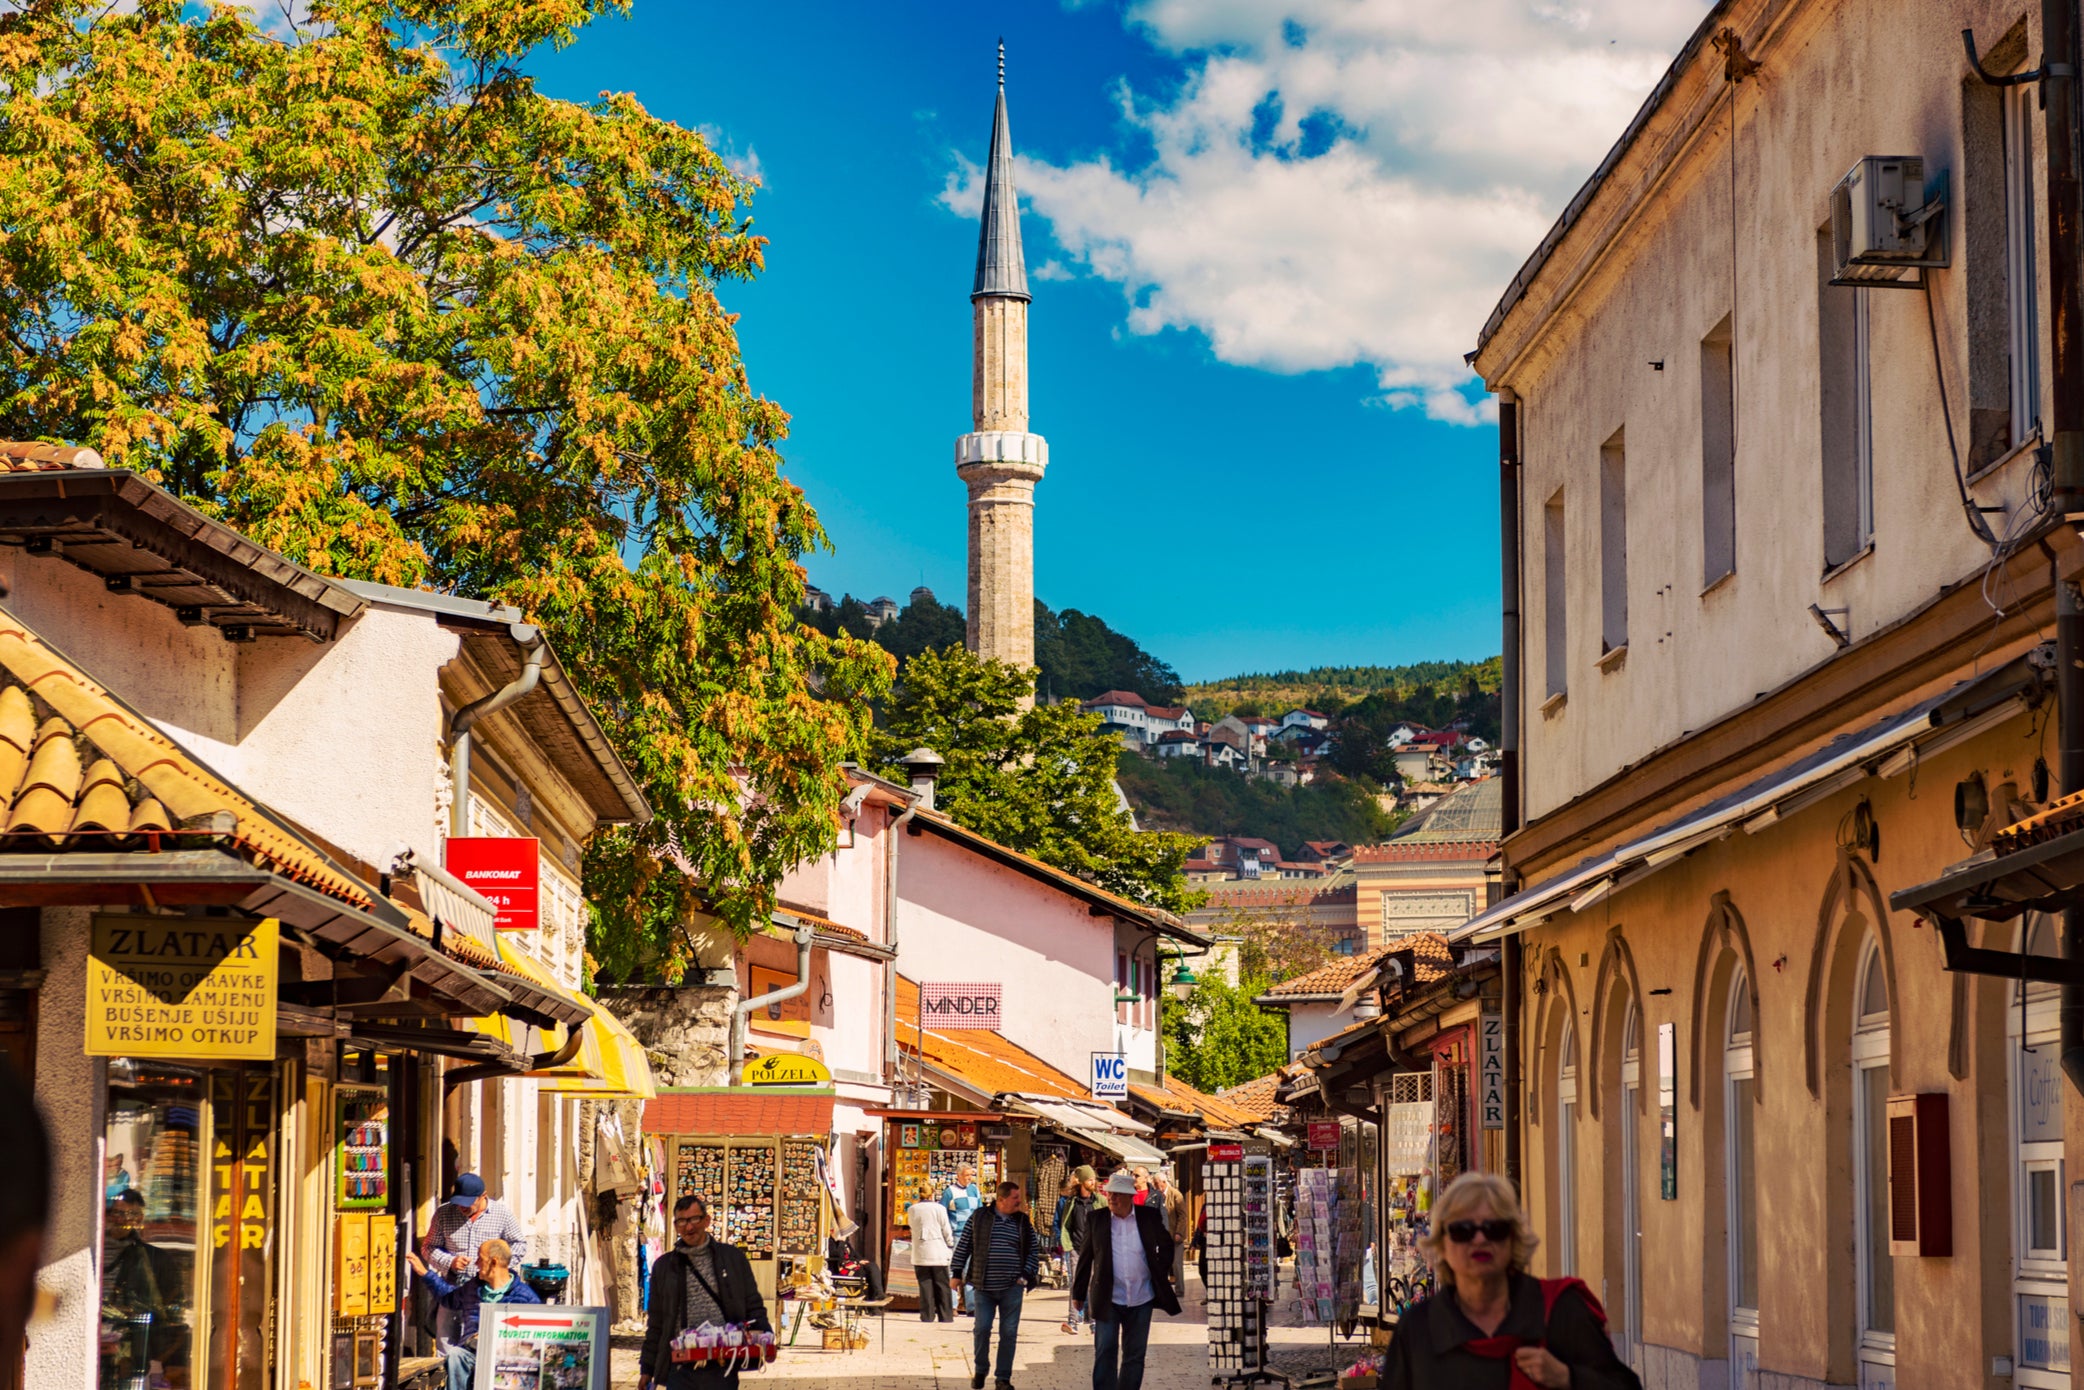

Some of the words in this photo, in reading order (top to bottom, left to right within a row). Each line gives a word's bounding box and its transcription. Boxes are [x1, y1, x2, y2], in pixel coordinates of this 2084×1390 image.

[465, 870, 521, 879] BANKOMAT
[108, 929, 260, 959] ZLATAR
[101, 968, 174, 986] VRŠIMO
[179, 972, 266, 990] OPRAVKE
[100, 986, 172, 1004] VRŠIMO
[179, 990, 265, 1008] ZAMJENU
[926, 996, 997, 1015] MINDER
[105, 1005, 194, 1024] BUŠENJE
[203, 1007, 259, 1026] UŠIJU
[106, 1024, 184, 1042] VRŠIMO
[192, 1028, 259, 1044] OTKUP
[751, 1069, 818, 1080] POLZELA
[1095, 1058, 1125, 1079] WC
[1484, 1021, 1502, 1121] ZLATAR
[1095, 1082, 1125, 1090] Toilet
[241, 1077, 269, 1249] ZLATAR
[498, 1329, 531, 1339] TOURIST
[532, 1331, 589, 1341] INFORMATION
